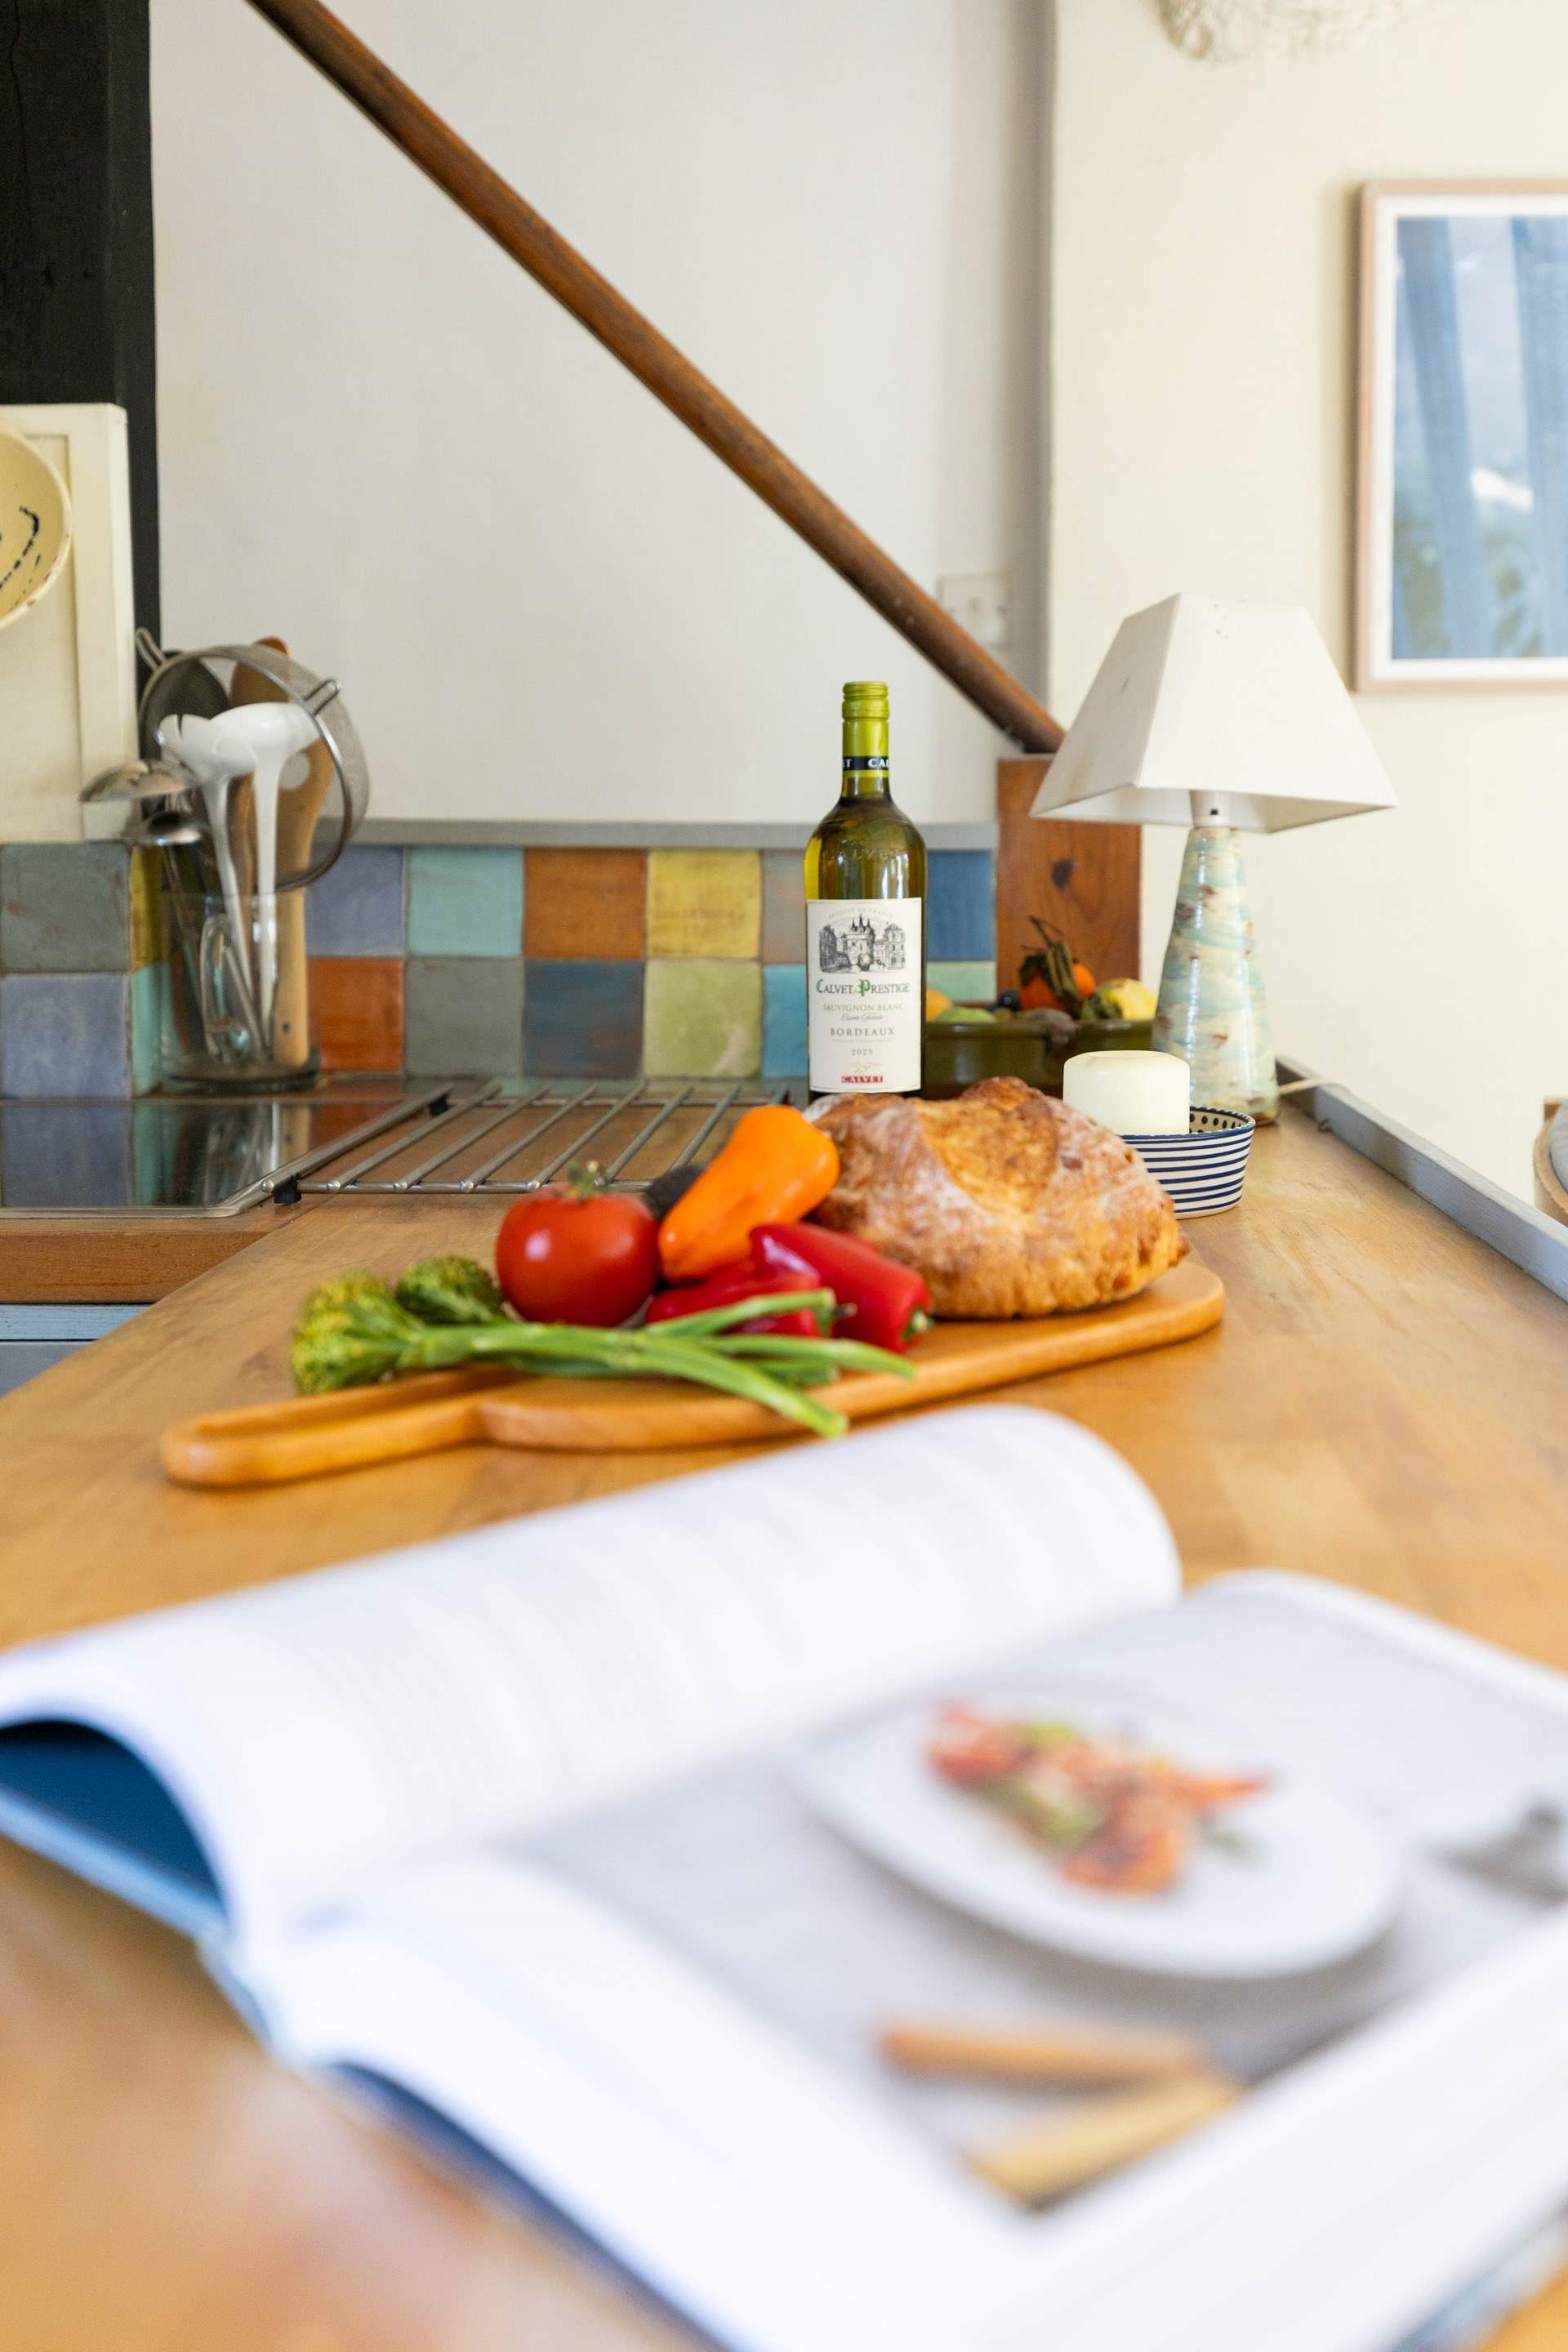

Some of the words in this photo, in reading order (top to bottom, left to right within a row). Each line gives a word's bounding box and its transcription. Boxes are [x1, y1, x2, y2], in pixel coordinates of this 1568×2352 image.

[816, 978, 854, 994] CALVET
[858, 978, 911, 996] PRESTIGE
[822, 1002, 875, 1013] SAUVIGNON
[878, 1003, 904, 1012] BLANC
[831, 1027, 895, 1037] BORDEAUX
[842, 1075, 883, 1084] CALVET
